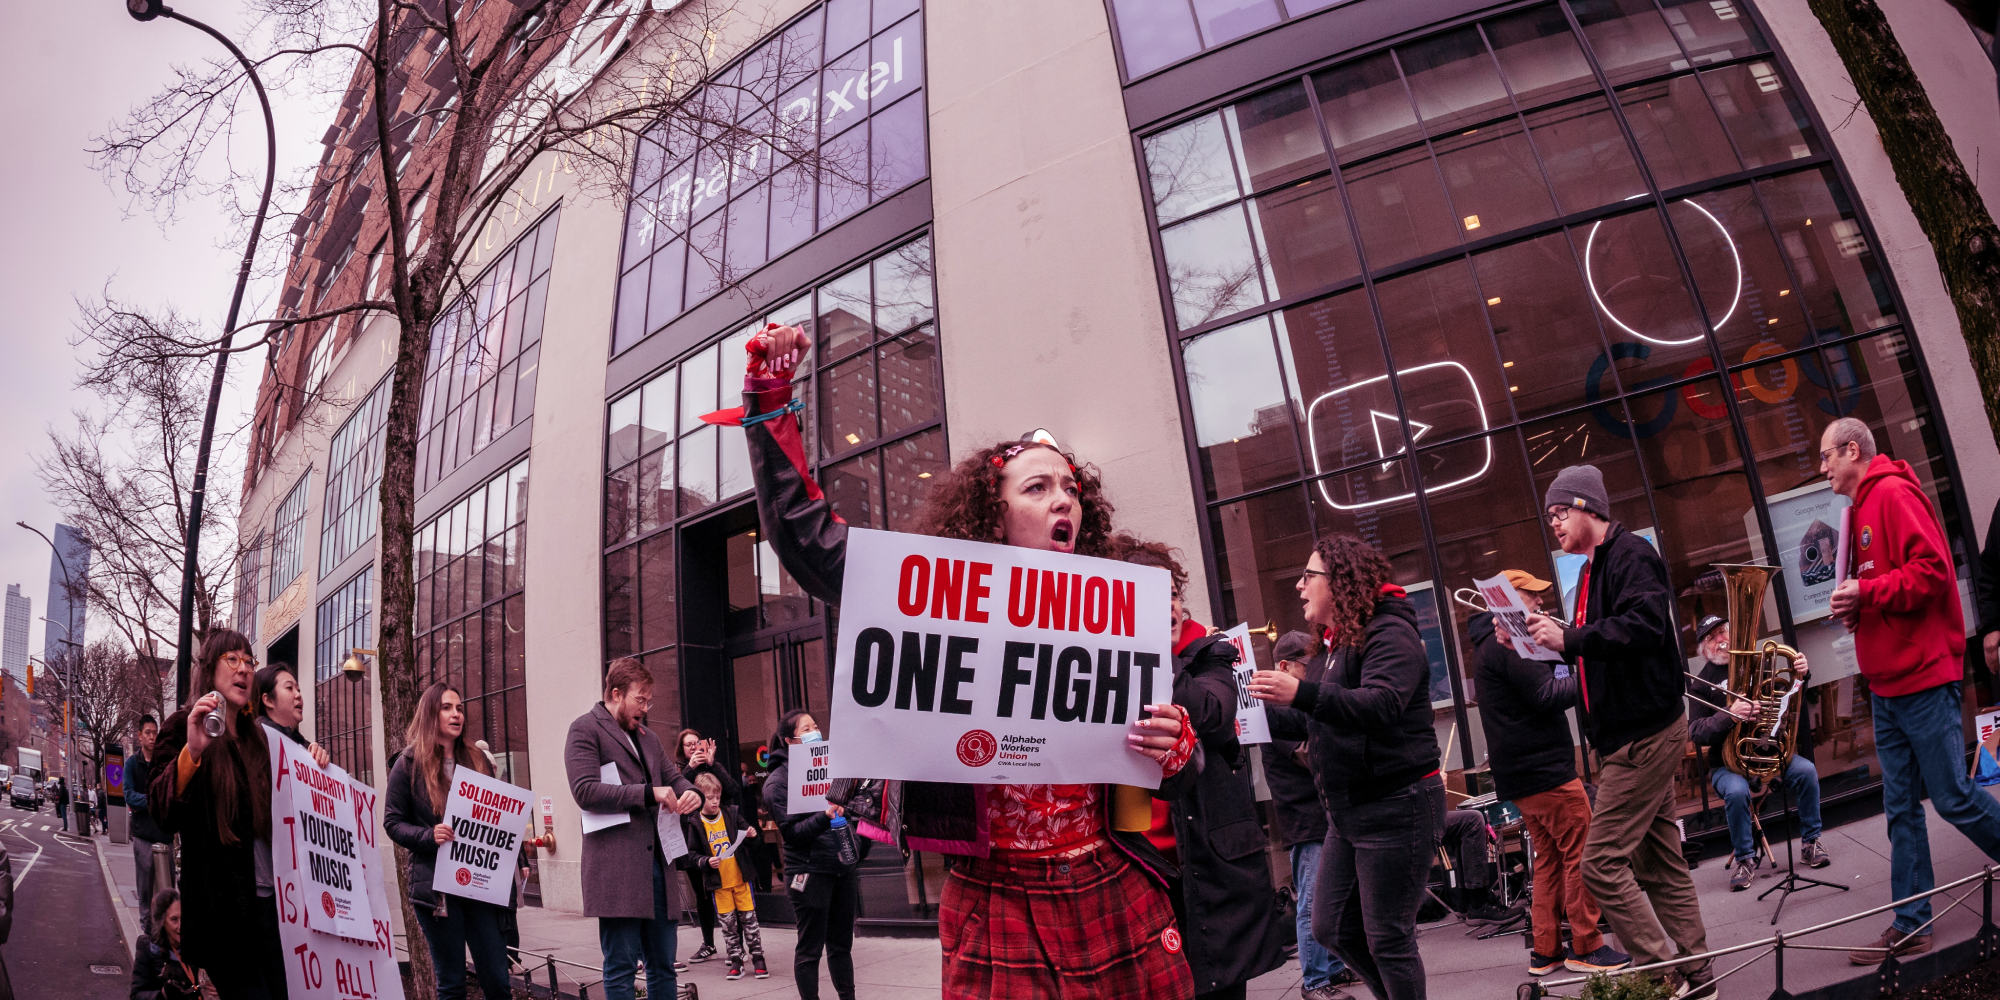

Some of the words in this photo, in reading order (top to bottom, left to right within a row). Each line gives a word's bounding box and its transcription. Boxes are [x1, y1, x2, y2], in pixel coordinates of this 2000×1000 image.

[637, 36, 904, 247] #TeamPixel
[1795, 505, 1815, 516] Google
[1815, 501, 1831, 510] Home
[897, 554, 993, 624] ONE
[1006, 566, 1136, 637] UNION
[851, 627, 980, 715] ONE
[996, 641, 1160, 725] FIGHT
[1000, 744, 1039, 753] Workers
[1001, 735, 1047, 745] Alphabet
[812, 757, 822, 767] ON
[999, 752, 1028, 760] Union
[293, 759, 347, 803] SOLIDARITY
[807, 768, 828, 782] GOO
[310, 789, 336, 820] WITH
[458, 781, 525, 816] SOLIDARITY
[471, 803, 502, 826] WITH
[299, 810, 356, 859] YOUTUBE
[451, 815, 517, 851] YOUTUBE
[308, 850, 352, 892] MUSIC
[449, 840, 500, 871] MUSIC
[277, 876, 298, 925] IS
[334, 896, 352, 906] Alphabet
[335, 903, 351, 912] Workers
[336, 909, 348, 917] Union
[294, 943, 322, 990] TO
[336, 957, 377, 1000] ALL!
